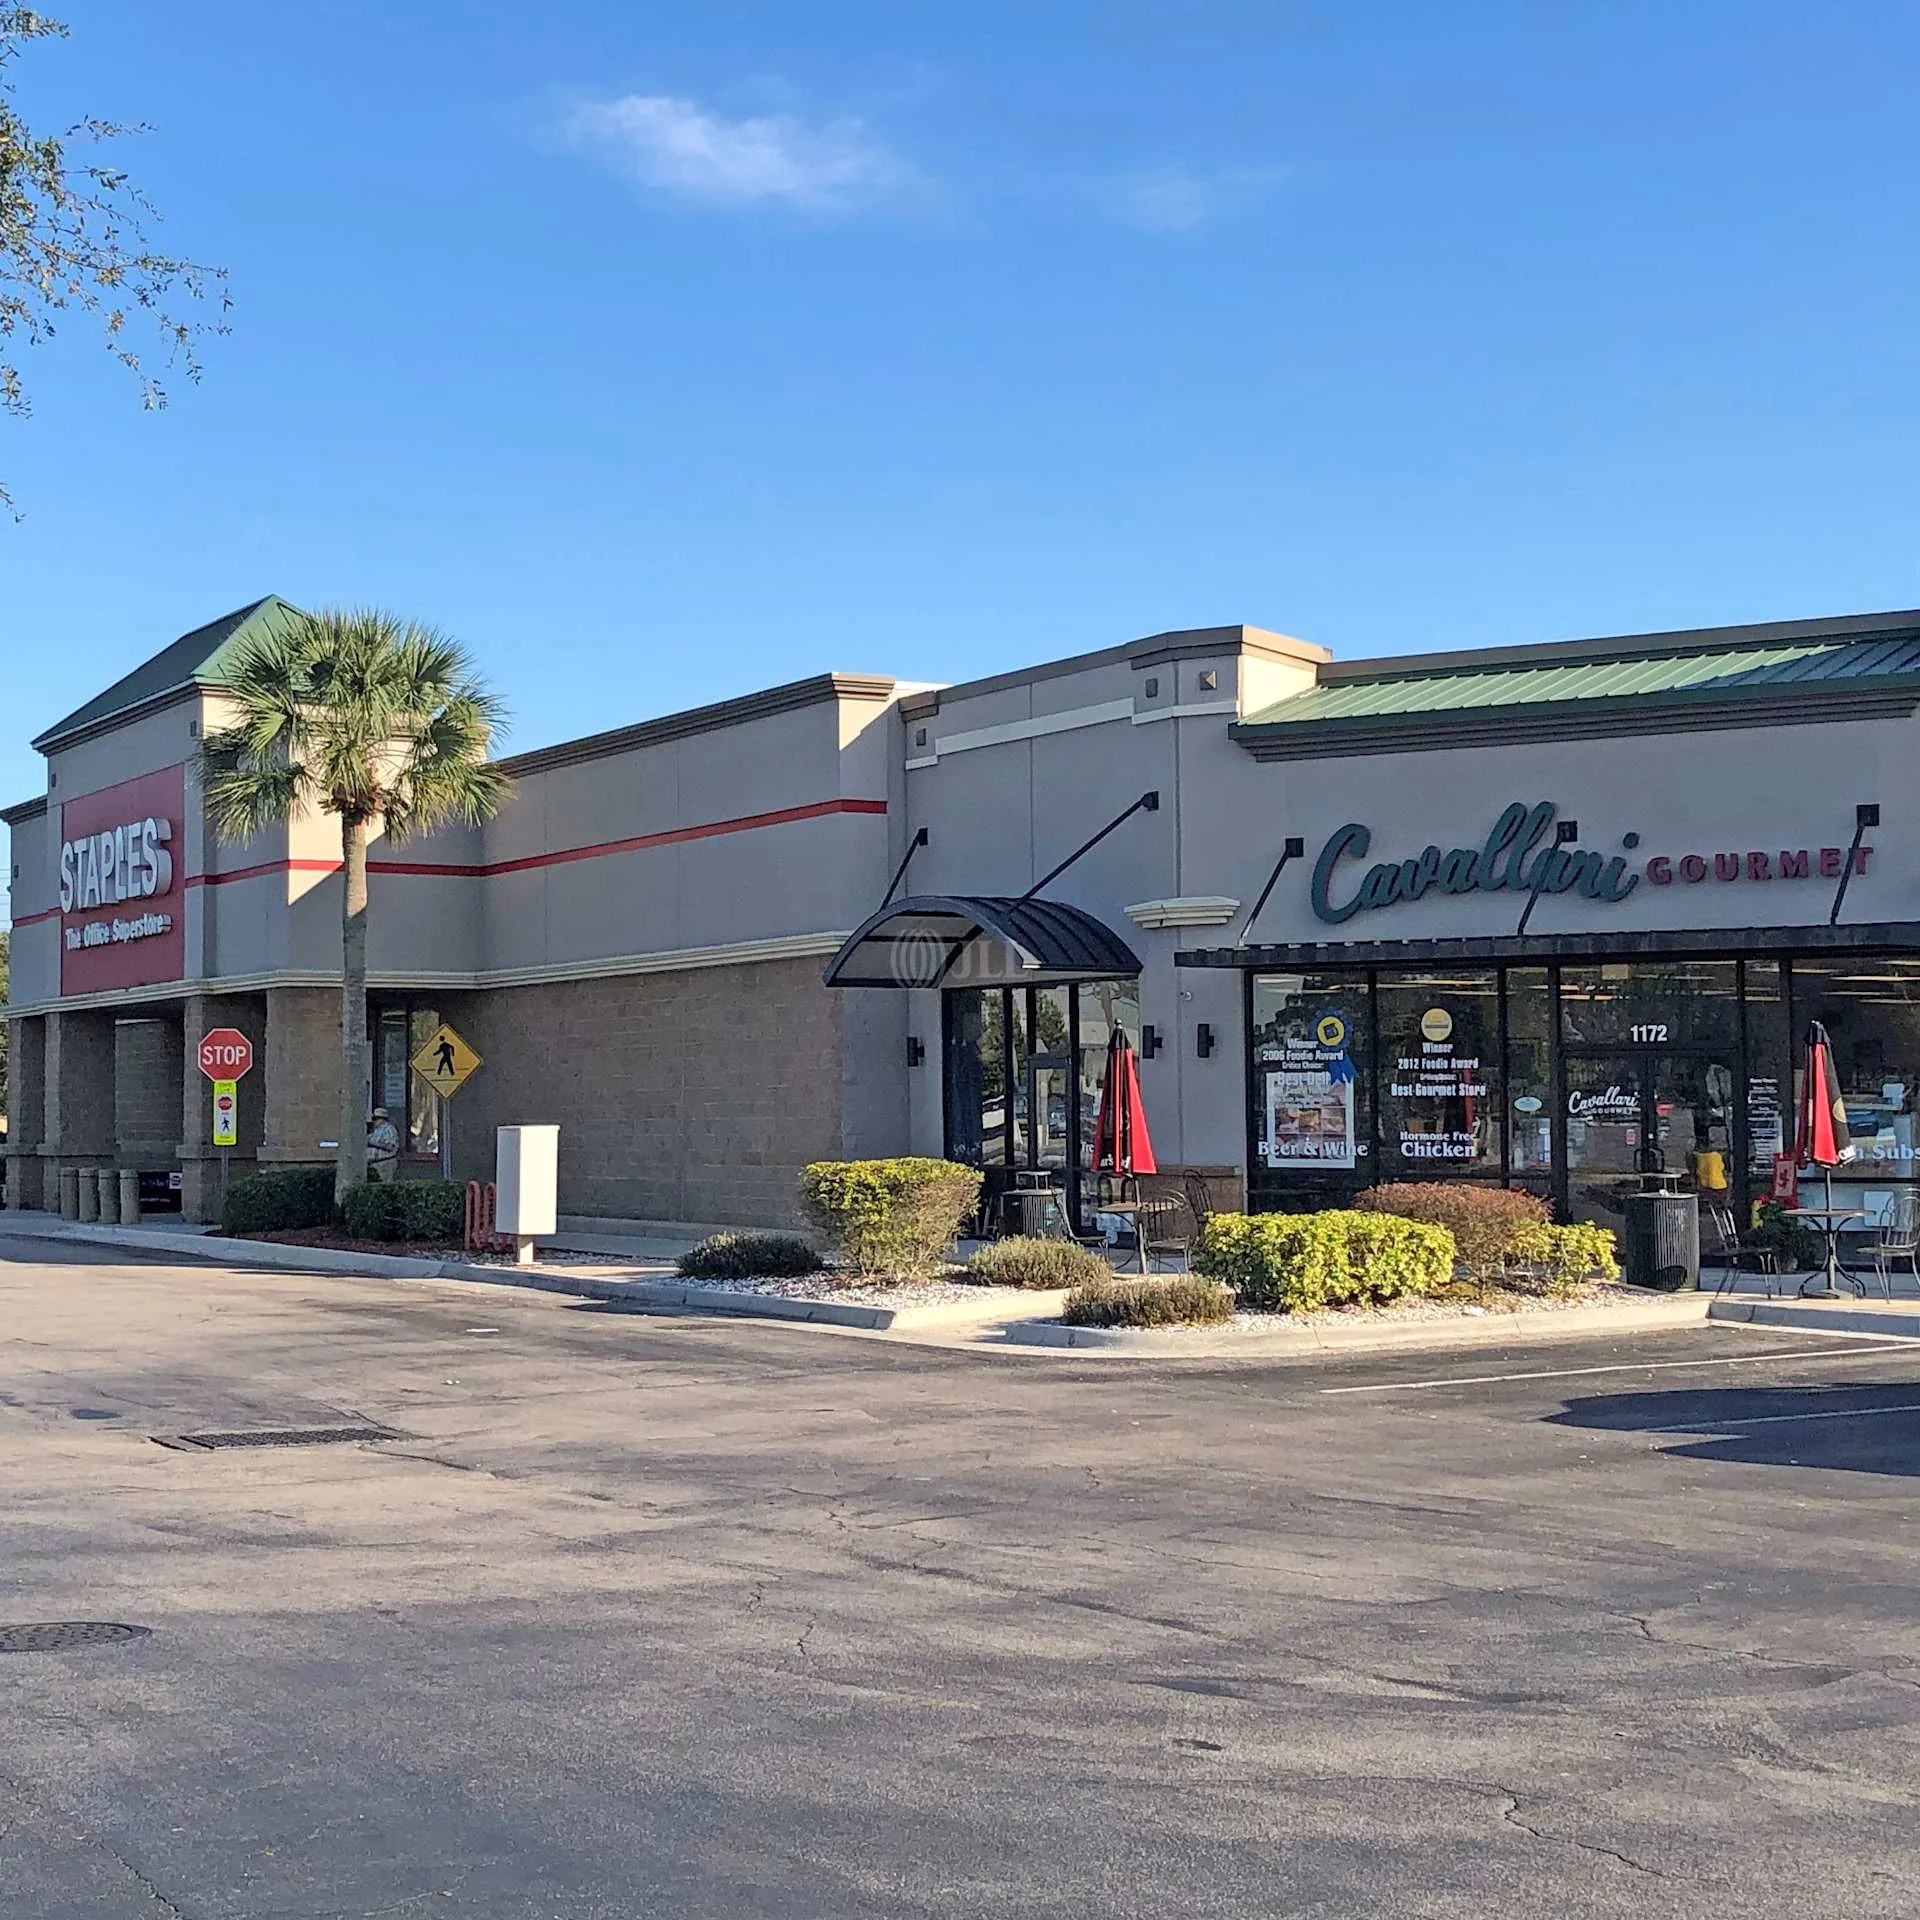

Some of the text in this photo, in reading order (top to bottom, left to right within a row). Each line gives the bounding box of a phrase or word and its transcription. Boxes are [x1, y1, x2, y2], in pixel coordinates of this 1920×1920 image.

[60, 817, 172, 913] STAPLES
[1312, 801, 1873, 924] Cavallari GOURMET
[66, 912, 172, 950] The Office Superstore
[1630, 1024, 1668, 1042] 1172
[202, 1045, 247, 1066] STOP
[1314, 1050, 1343, 1061] Award
[1422, 1042, 1454, 1054] Winner
[1398, 1057, 1479, 1070] 2012 Foodie Award
[1391, 1083, 1486, 1096] Best Gourmet Store
[1568, 1086, 1640, 1114] Cavallari
[1400, 1131, 1475, 1141] Hormone Free
[1258, 1141, 1368, 1156] Beer & Wine
[1401, 1142, 1476, 1157] Chicken
